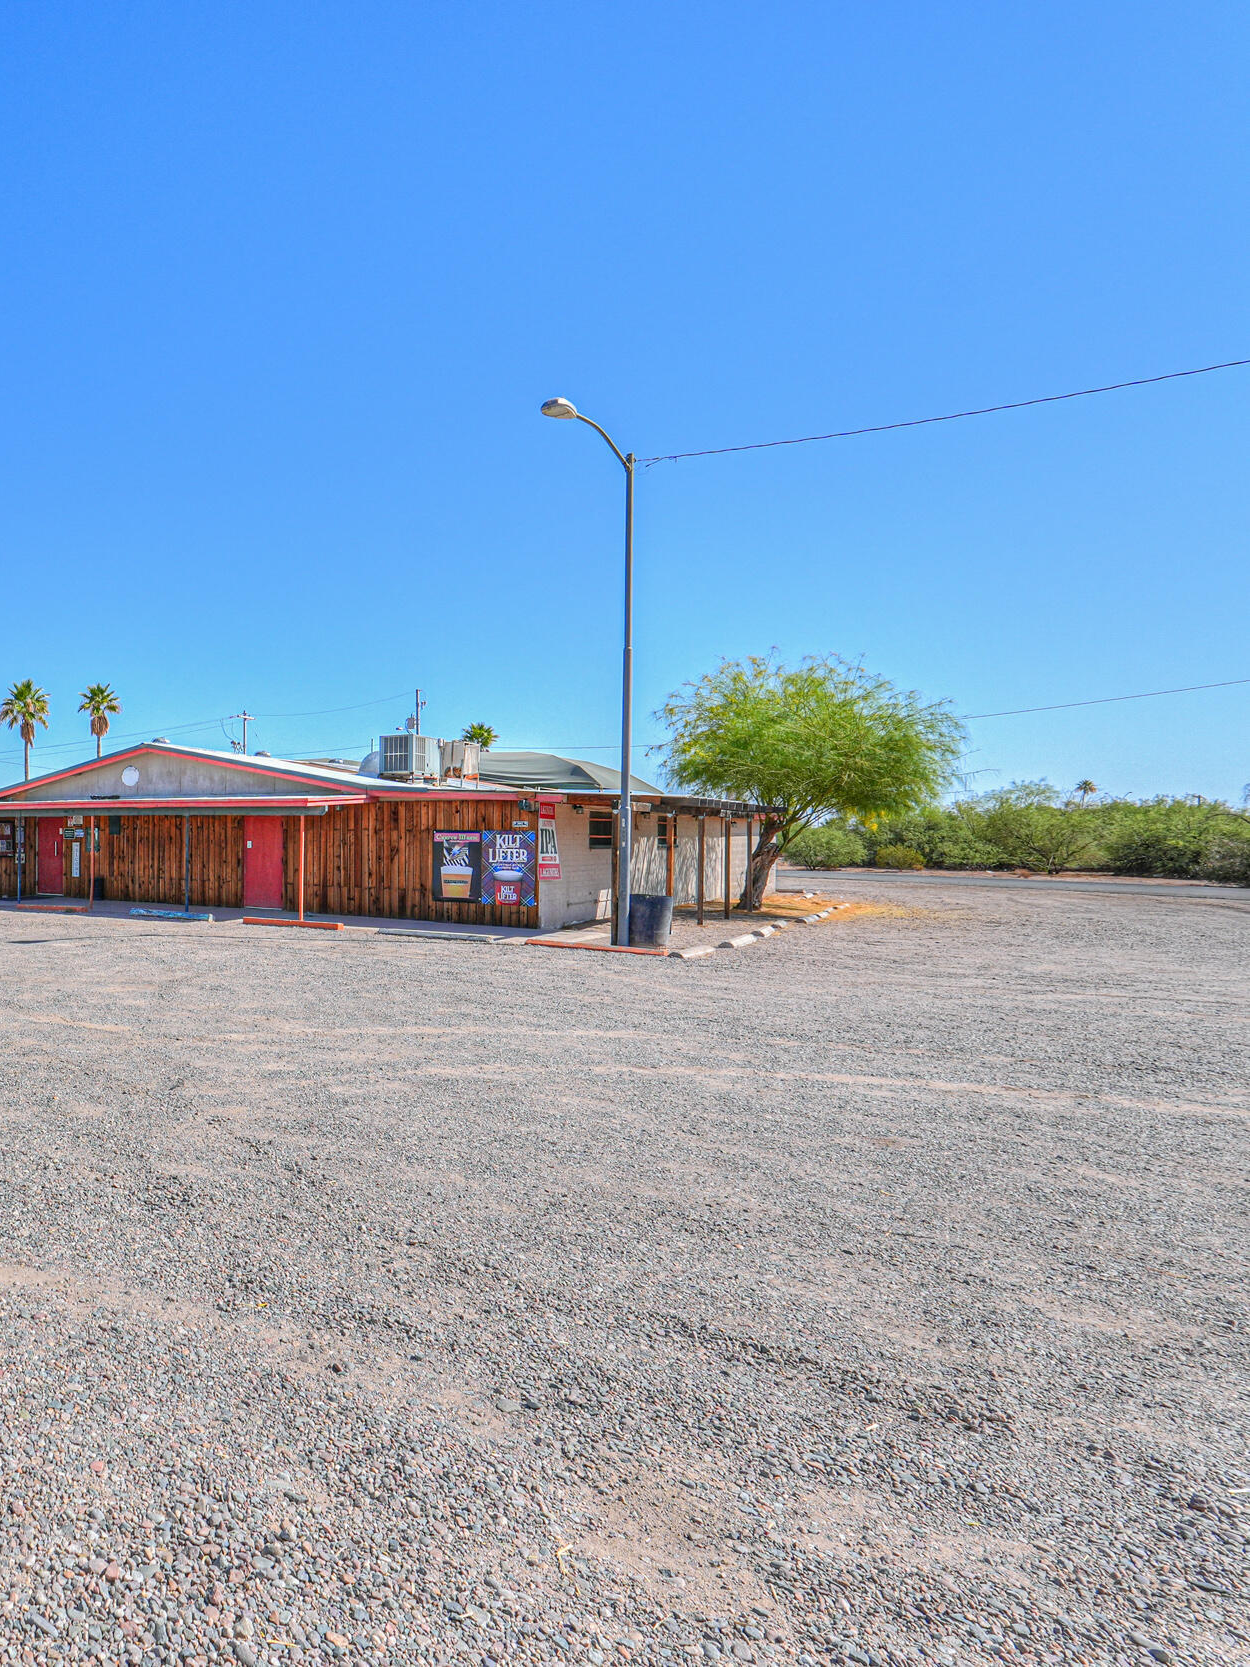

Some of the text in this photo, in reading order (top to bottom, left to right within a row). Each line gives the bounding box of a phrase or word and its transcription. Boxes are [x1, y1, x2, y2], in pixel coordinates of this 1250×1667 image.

[495, 834, 523, 849] KILT
[540, 828, 558, 855] IPA
[488, 848, 528, 863] LIFTER
[500, 885, 515, 894] KILT
